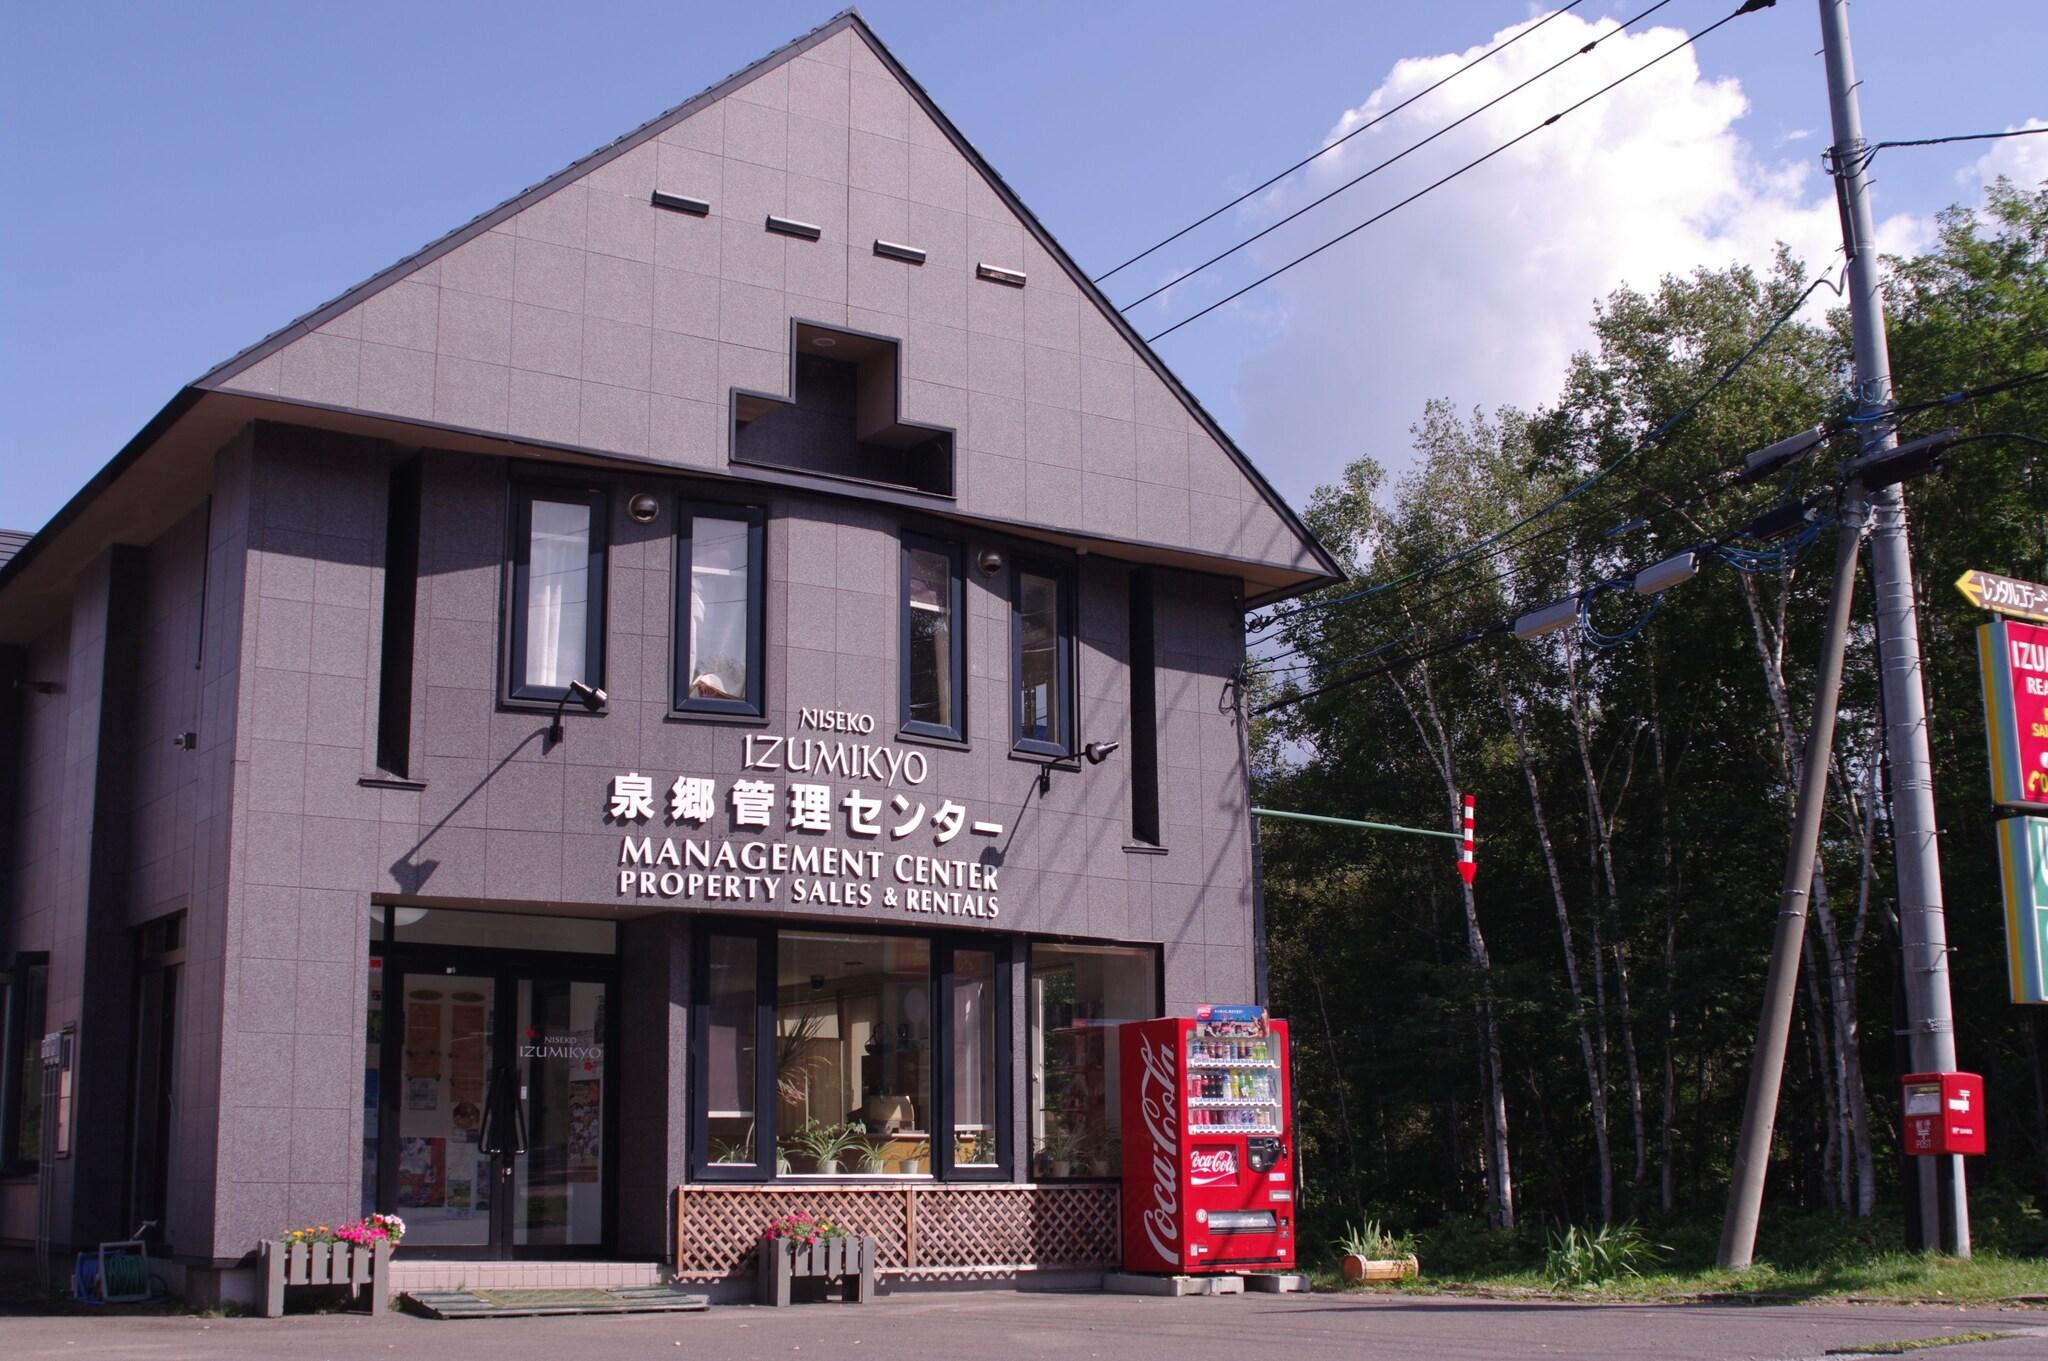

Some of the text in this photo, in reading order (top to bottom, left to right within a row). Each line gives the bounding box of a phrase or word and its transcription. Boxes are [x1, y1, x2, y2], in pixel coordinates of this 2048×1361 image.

[2011, 640, 2048, 673] IZU
[800, 707, 875, 734] NISEKO
[743, 734, 928, 788] IZUMIKYO
[610, 772, 1003, 844] 泉郷管理センター
[620, 836, 998, 890] MANAGEMENT CENTER
[620, 871, 999, 918] PROPERTY SALES & RENTALS
[520, 1046, 601, 1060] IZUMIKYO
[544, 1036, 577, 1044] NISEKO
[1141, 1032, 1179, 1265] Coca-Cola
[1190, 1150, 1237, 1173] Coca-Cola
